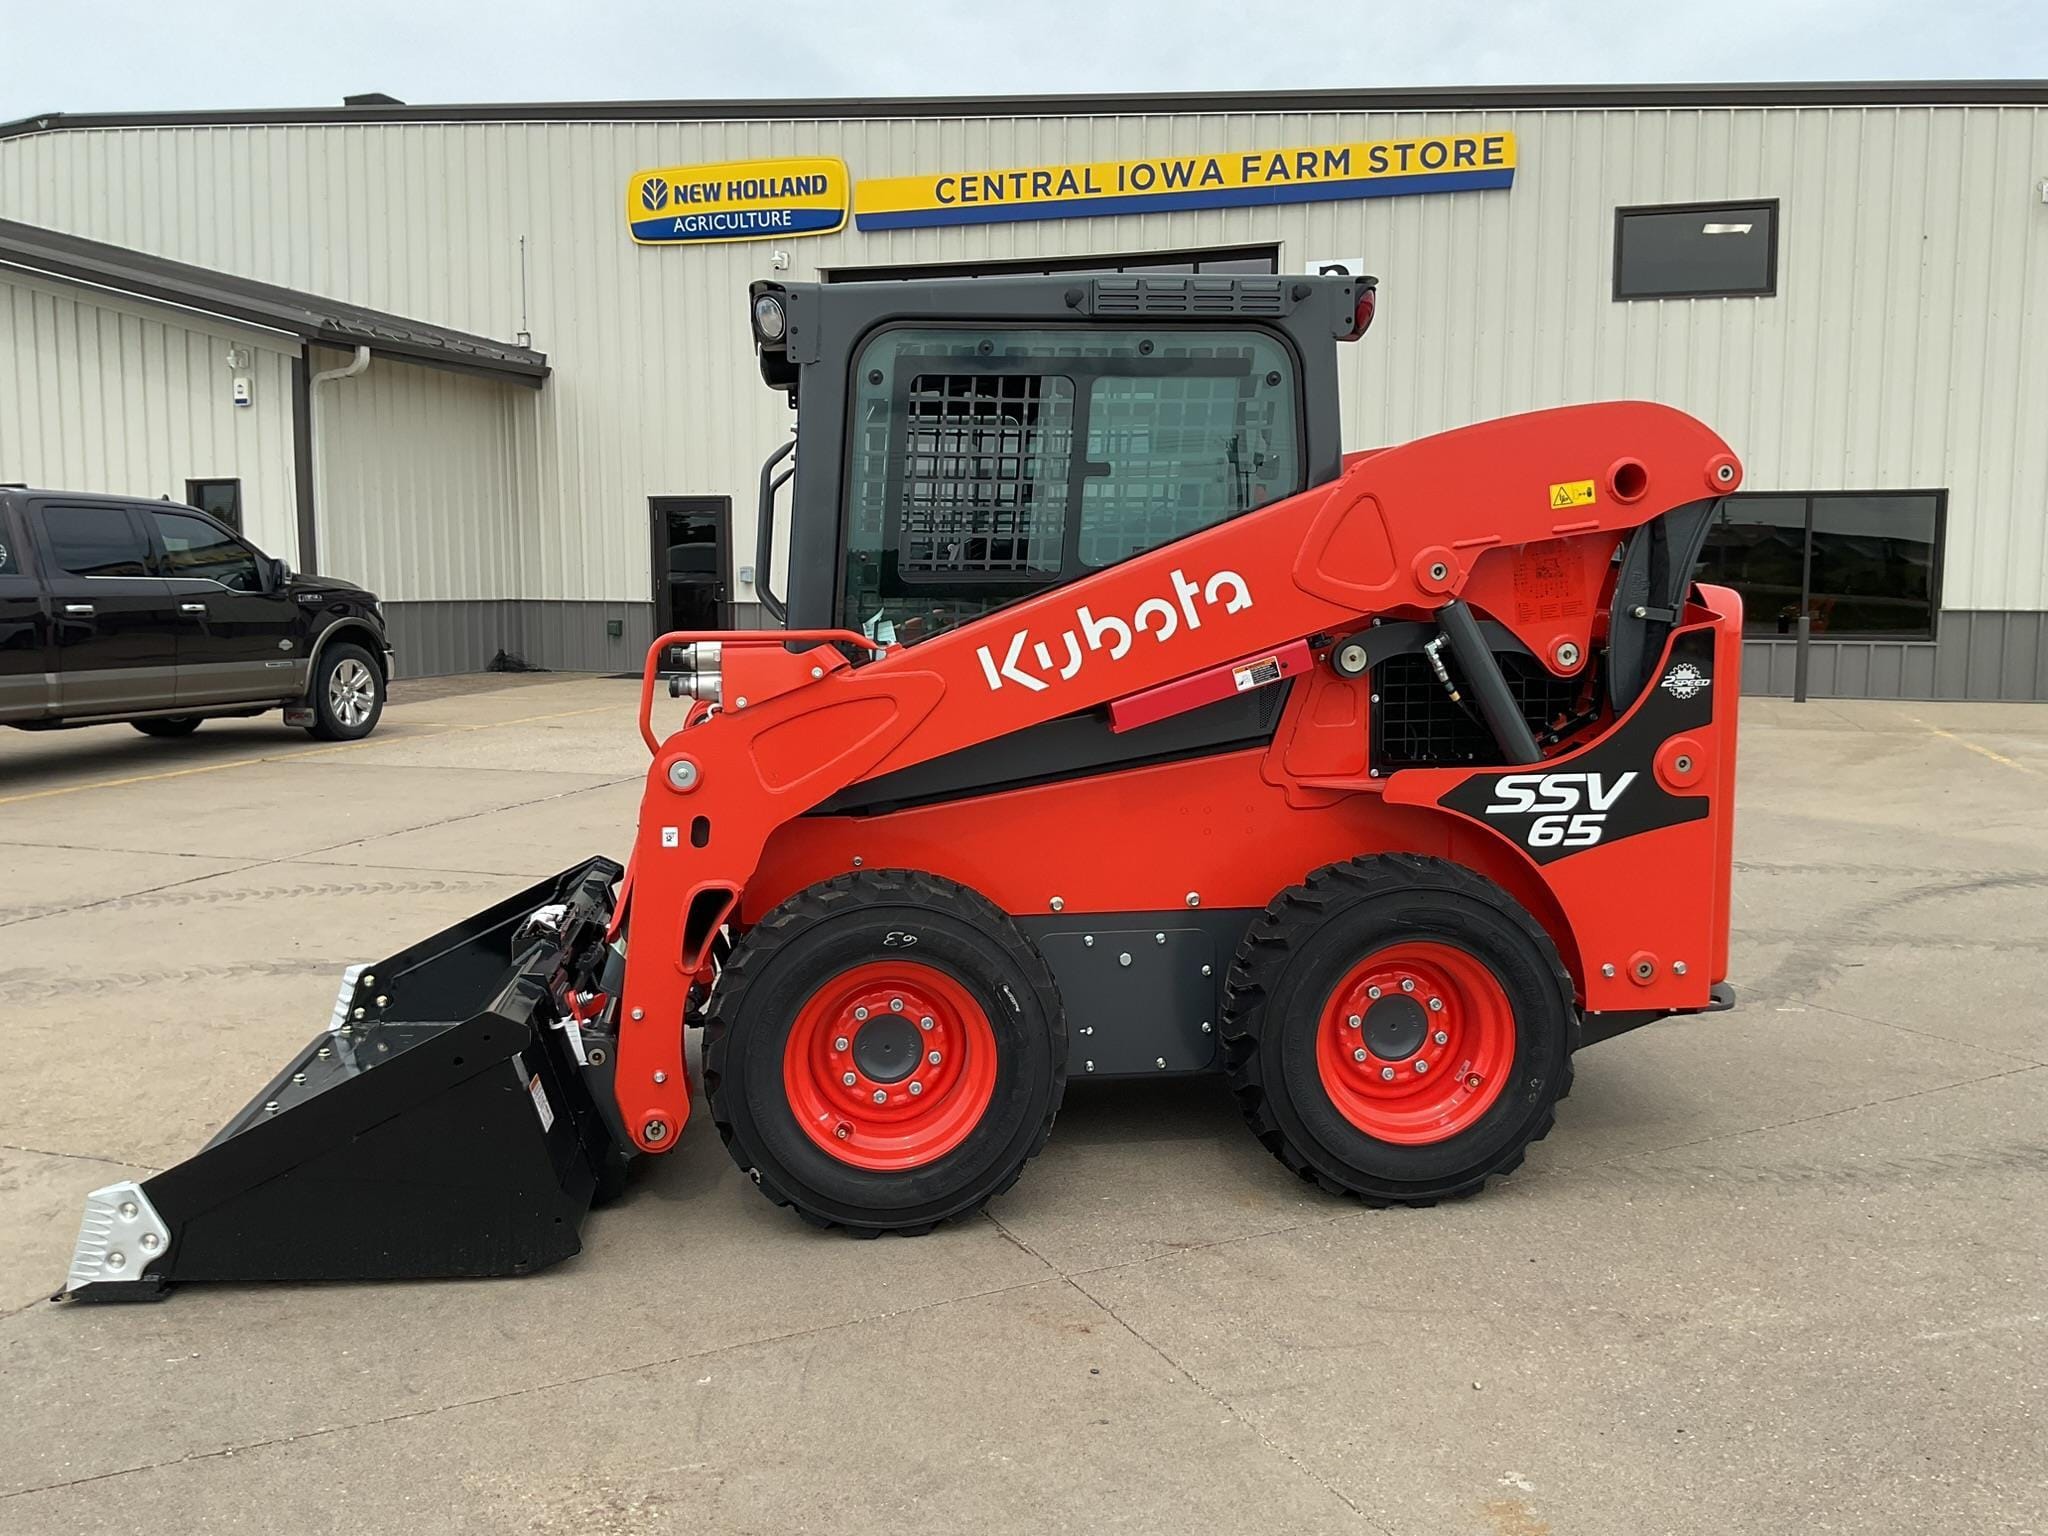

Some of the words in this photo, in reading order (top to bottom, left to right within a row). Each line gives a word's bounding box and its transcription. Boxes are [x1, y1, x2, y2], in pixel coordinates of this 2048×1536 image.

[935, 168, 1101, 204] CENTRAL
[1118, 158, 1225, 192] IOWA
[1241, 148, 1350, 183] FARM
[1368, 137, 1504, 174] STORE
[674, 182, 722, 205] NEW
[728, 175, 827, 201] HOLLAND
[674, 210, 792, 233] AGRICULTURE
[976, 569, 1253, 692] Kubota
[1485, 772, 1640, 814] SSV
[1527, 814, 1608, 847] 65
